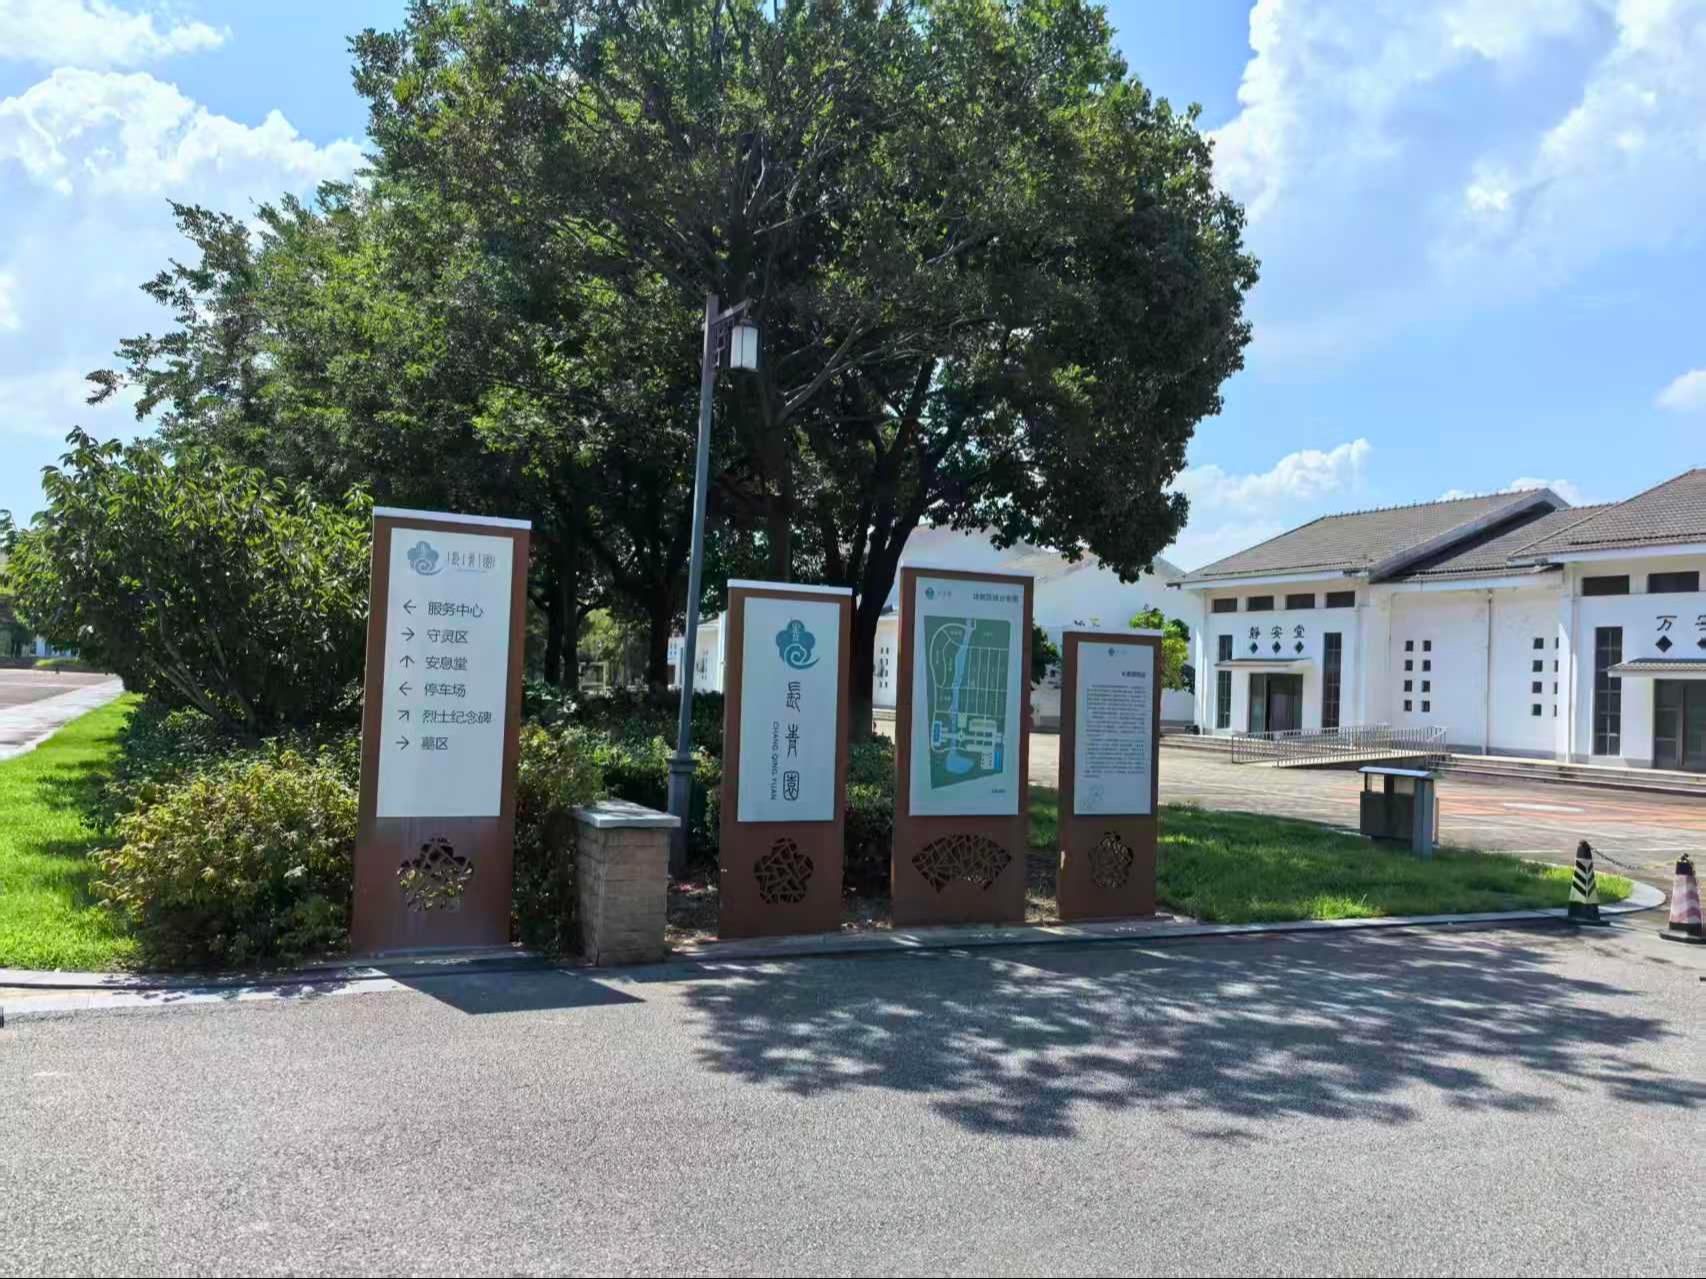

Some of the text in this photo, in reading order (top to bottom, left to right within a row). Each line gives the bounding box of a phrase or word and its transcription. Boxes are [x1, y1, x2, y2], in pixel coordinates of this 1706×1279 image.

[428, 600, 484, 618] 服务中心
[426, 628, 469, 644] 守灵区
[425, 655, 468, 671] 安息堂
[424, 683, 467, 698] 停车场
[422, 709, 493, 725] 烈士纪念碑
[421, 736, 449, 751] 墓区
[769, 721, 781, 801] CHANG QING YUAN
